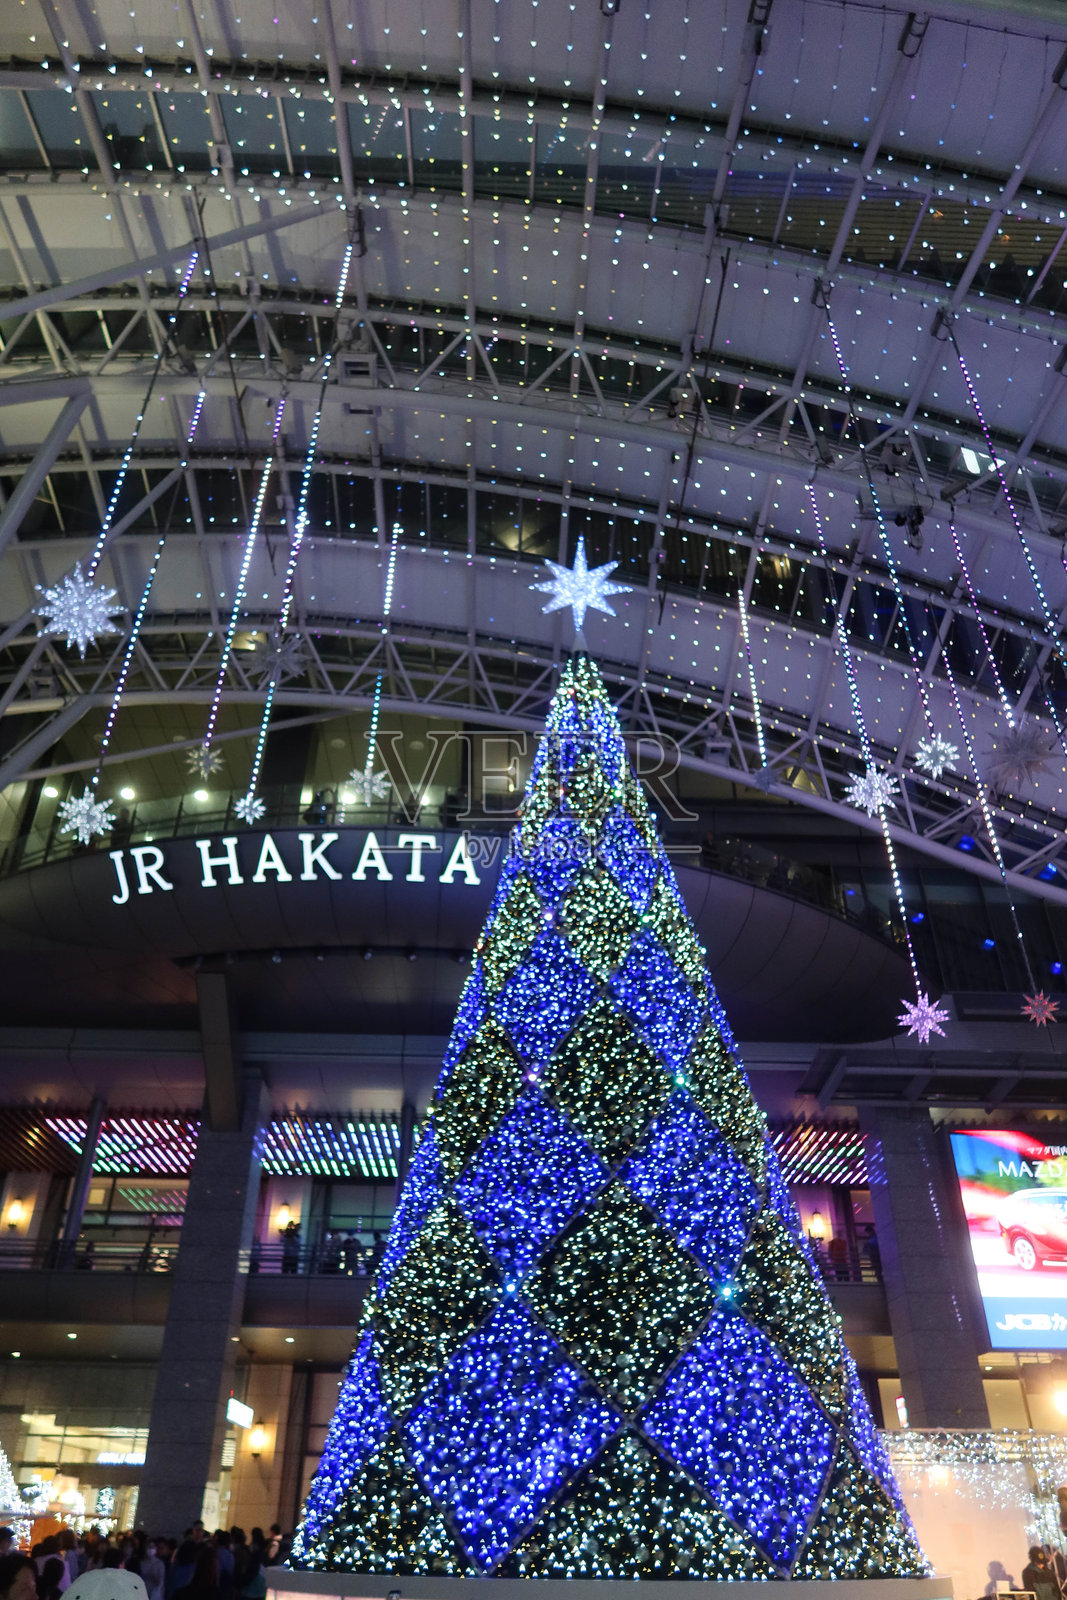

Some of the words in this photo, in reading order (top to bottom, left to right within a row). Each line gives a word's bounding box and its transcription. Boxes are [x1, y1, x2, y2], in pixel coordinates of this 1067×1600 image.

[108, 845, 174, 905] JR
[195, 832, 481, 887] HAKATA
[998, 1160, 1067, 1178] MAZD
